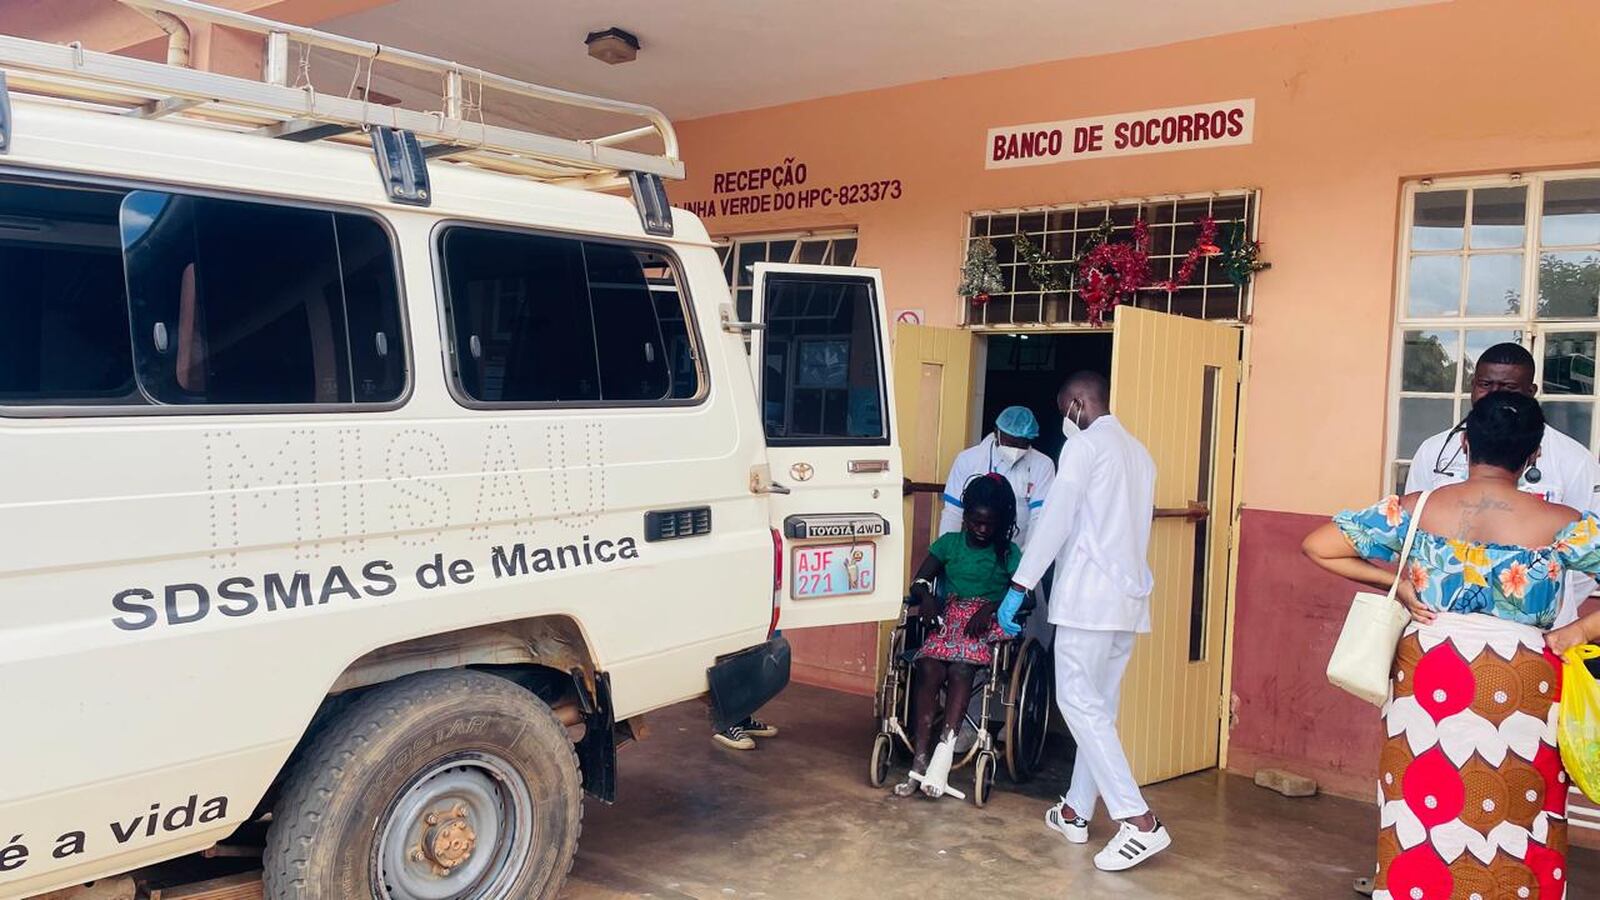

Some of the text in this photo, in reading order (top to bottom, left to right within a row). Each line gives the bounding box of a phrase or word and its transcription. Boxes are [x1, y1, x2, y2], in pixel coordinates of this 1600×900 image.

[992, 108, 1244, 161] BANCO DE SOCORROS
[713, 157, 807, 194] RECEPÇÃO
[721, 195, 771, 216] VERDE
[773, 192, 795, 212] DO
[798, 179, 903, 209] HPC-823373
[203, 422, 608, 570] MISAU
[811, 524, 882, 536] TOYOTA 4WD
[798, 551, 833, 572] AJF
[111, 534, 638, 631] SDSMAS de Manica
[798, 574, 832, 594] 271
[0, 794, 229, 873] é a vida
